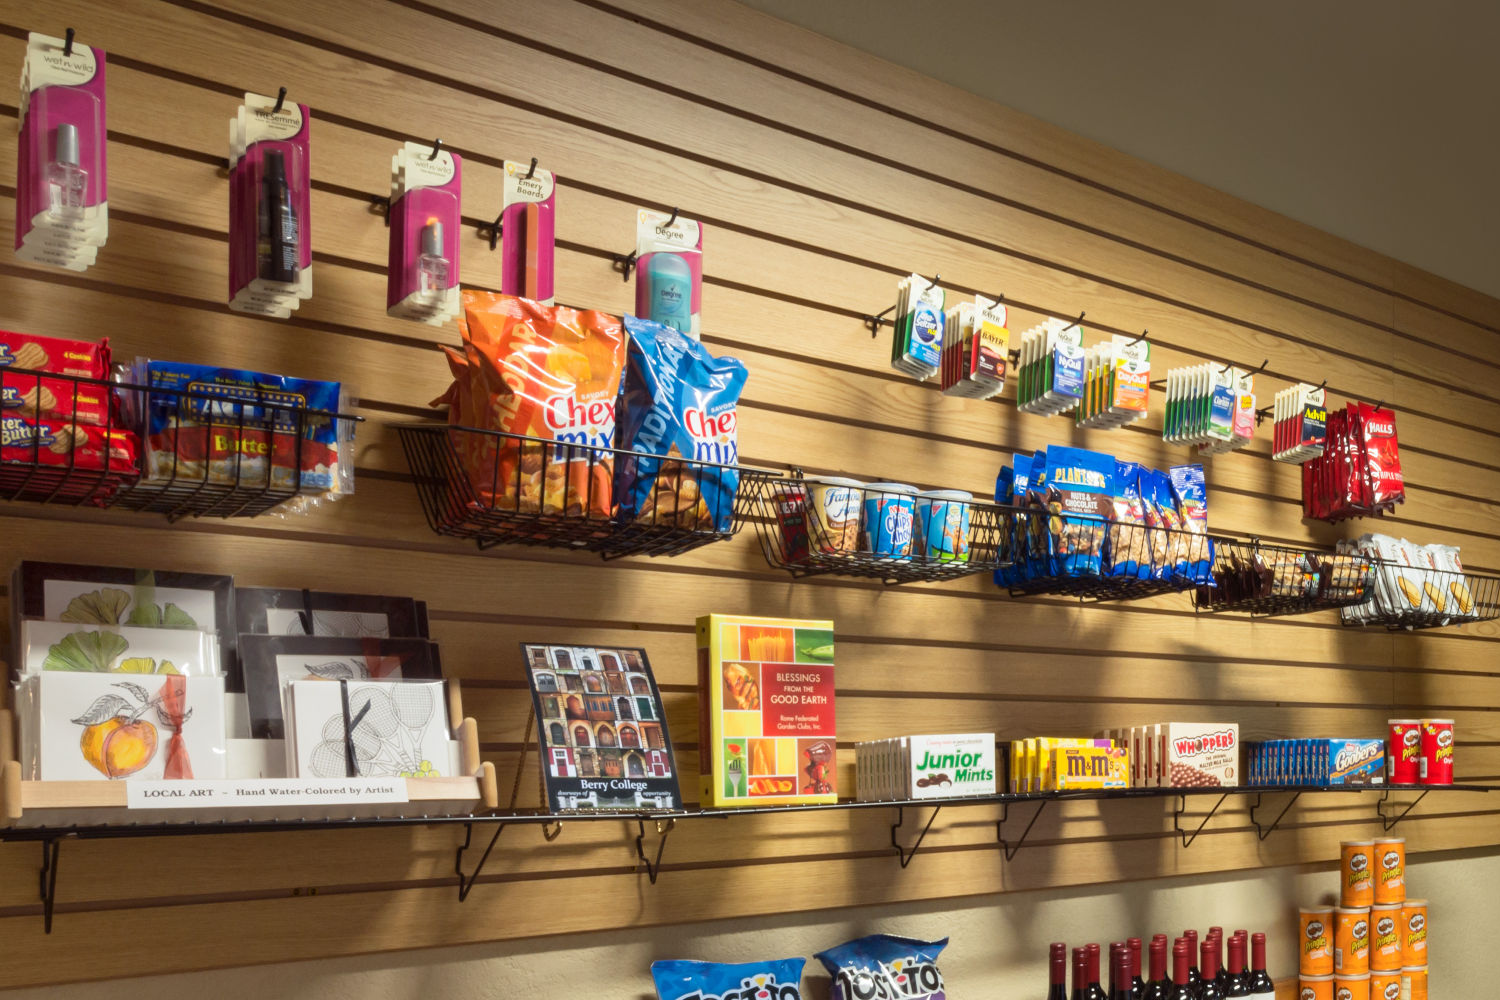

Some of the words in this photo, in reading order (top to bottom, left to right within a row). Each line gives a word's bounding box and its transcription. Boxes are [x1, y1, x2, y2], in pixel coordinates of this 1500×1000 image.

[518, 178, 543, 191] Emery
[516, 186, 544, 199] Boards
[655, 226, 684, 241] Degree
[982, 309, 1000, 322] BAYER
[982, 331, 1004, 347] BAYER
[1058, 355, 1082, 371] NyQuil
[546, 394, 616, 430] Chex
[1304, 408, 1326, 422] Advil
[1369, 422, 1393, 434] HALLS
[555, 427, 616, 461] mix
[776, 672, 821, 683] BLESSINGS
[803, 685, 814, 693] THE
[770, 695, 799, 704] GOOD
[801, 695, 827, 705] EARTH
[1175, 731, 1235, 756] WHOPPERS
[916, 750, 982, 771] Junior
[1335, 743, 1379, 772] Goobers
[954, 768, 993, 783] Mints
[143, 788, 186, 798] LOCAL
[188, 788, 214, 797] ART
[236, 788, 266, 796] Hand
[269, 786, 347, 797] Water-Colored
[350, 786, 361, 796] by
[365, 785, 394, 795] Artist
[580, 779, 608, 791] Berry
[610, 779, 648, 791] College
